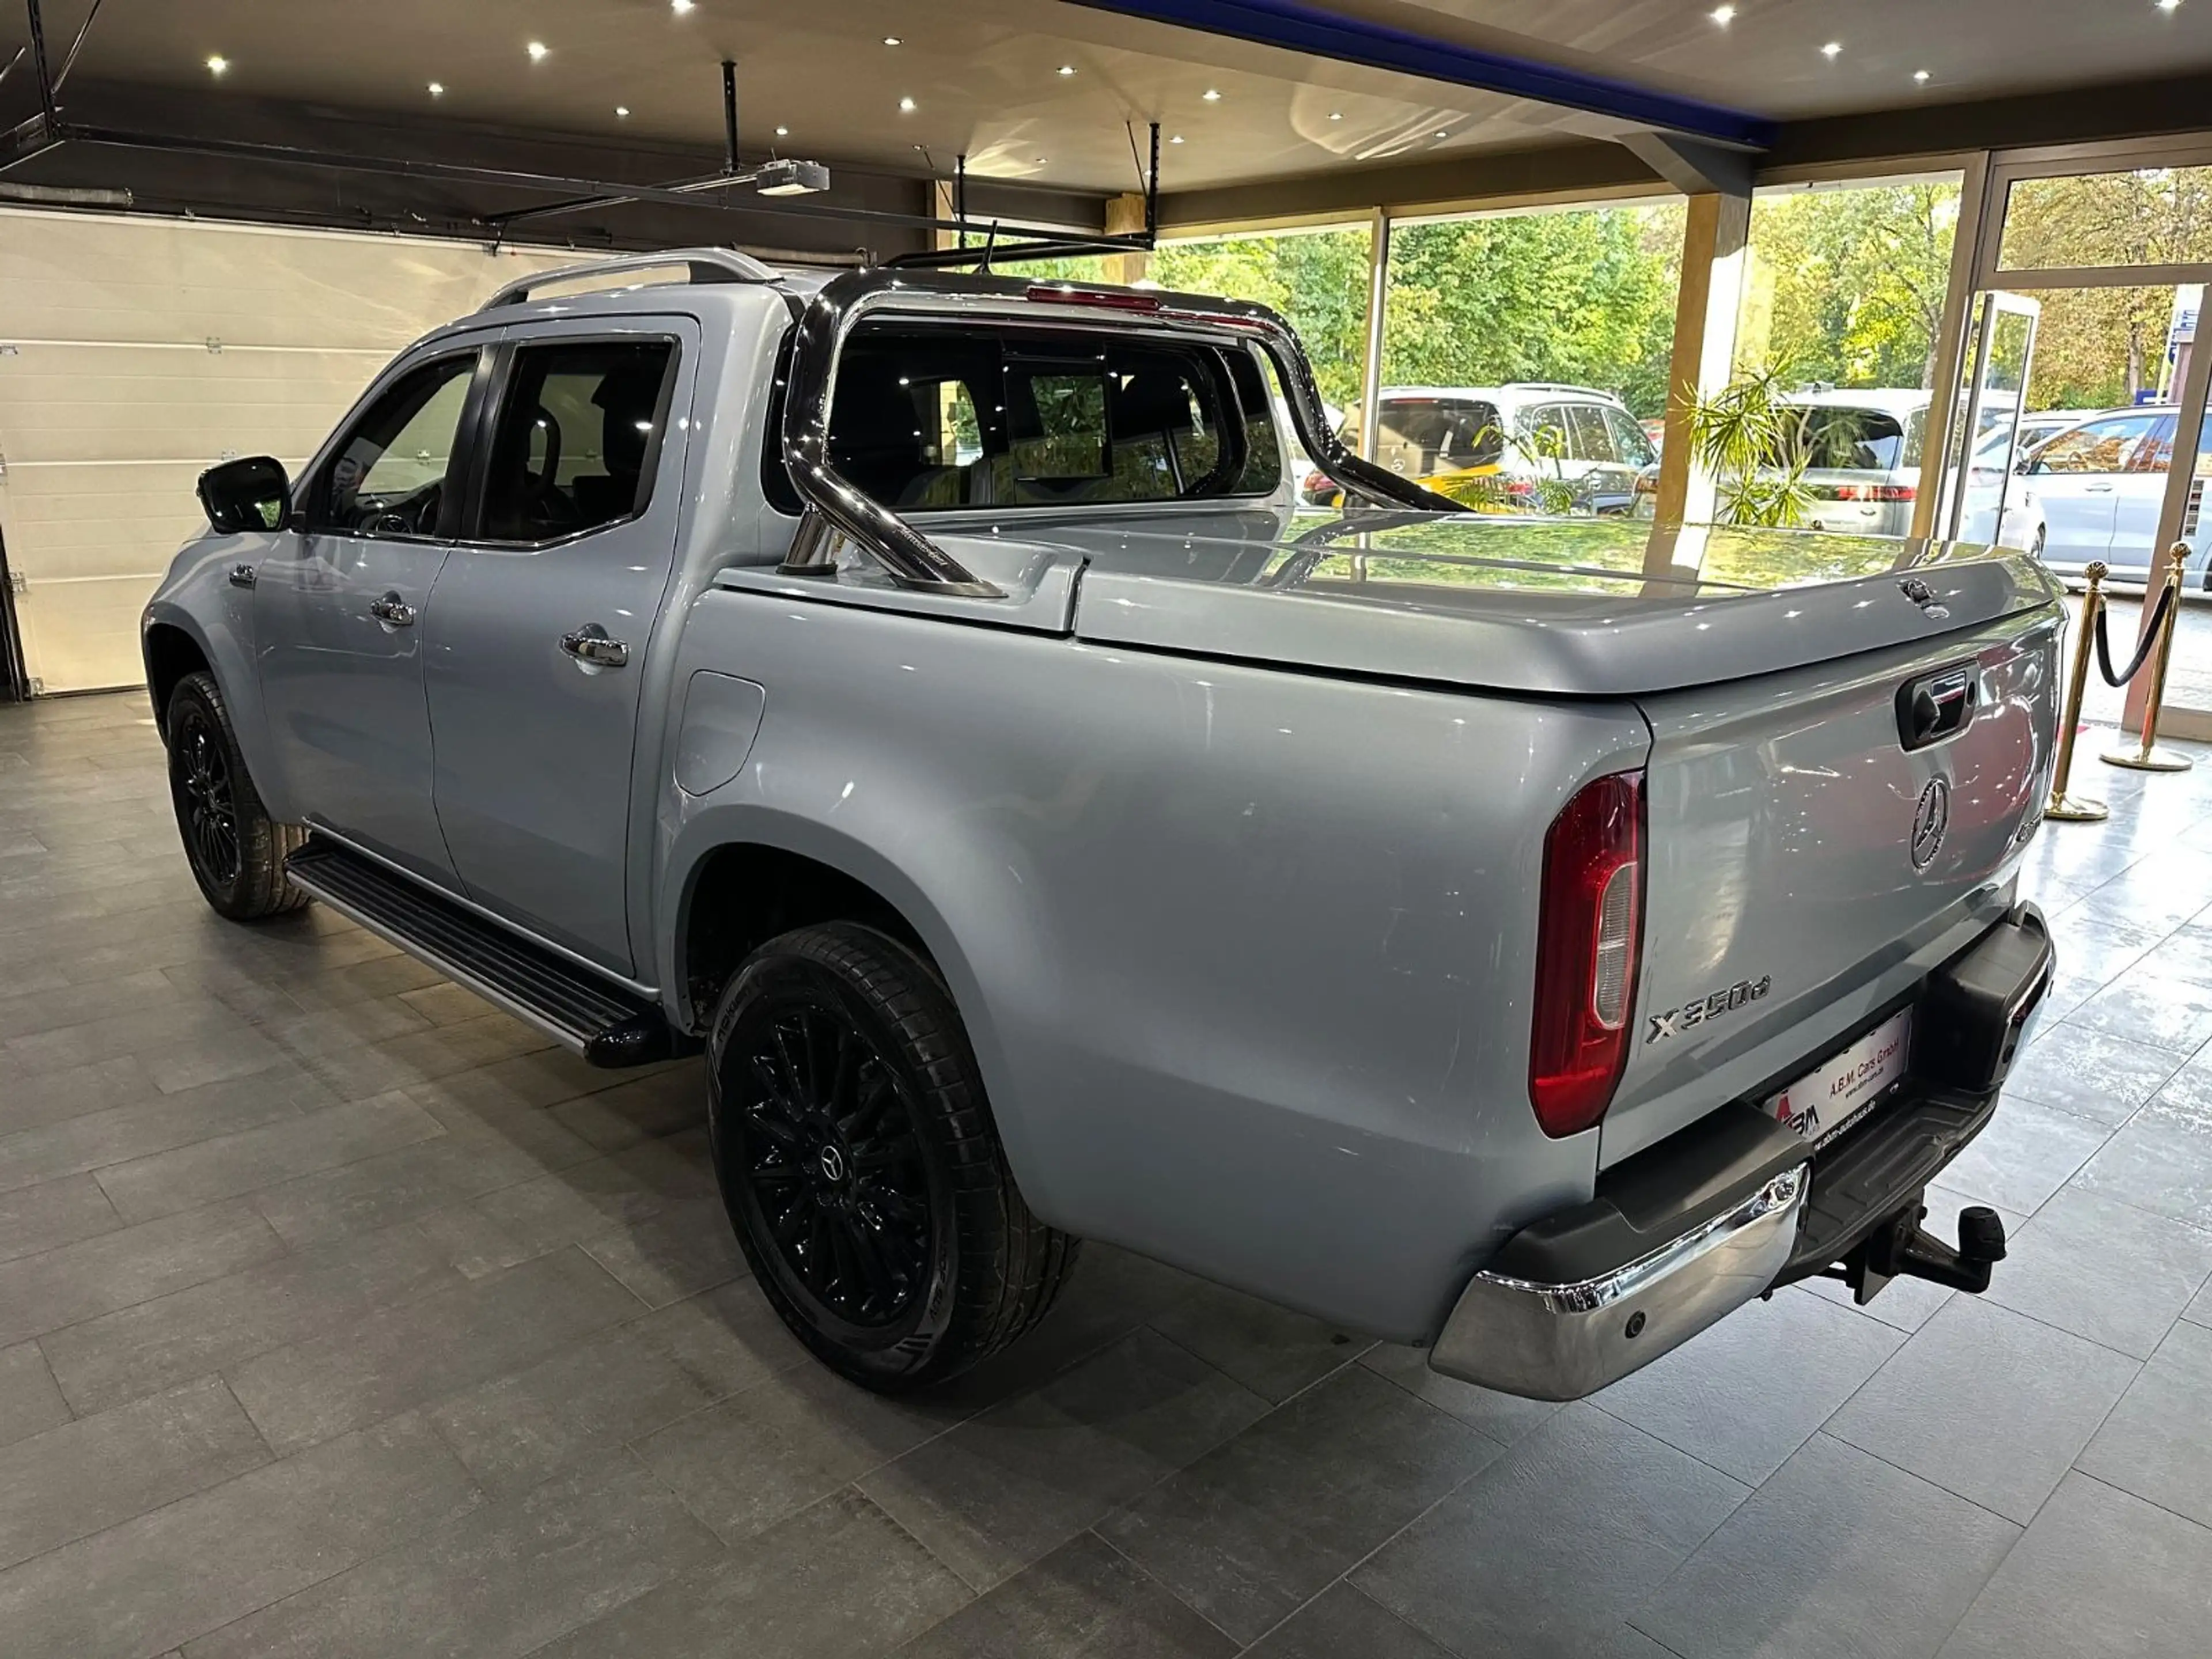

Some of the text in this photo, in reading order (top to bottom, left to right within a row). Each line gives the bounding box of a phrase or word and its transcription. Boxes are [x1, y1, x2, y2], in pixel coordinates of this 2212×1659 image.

[1646, 975, 1771, 1044] X 350d
[1829, 1037, 1899, 1099] A.B.M. Cars GmbH
